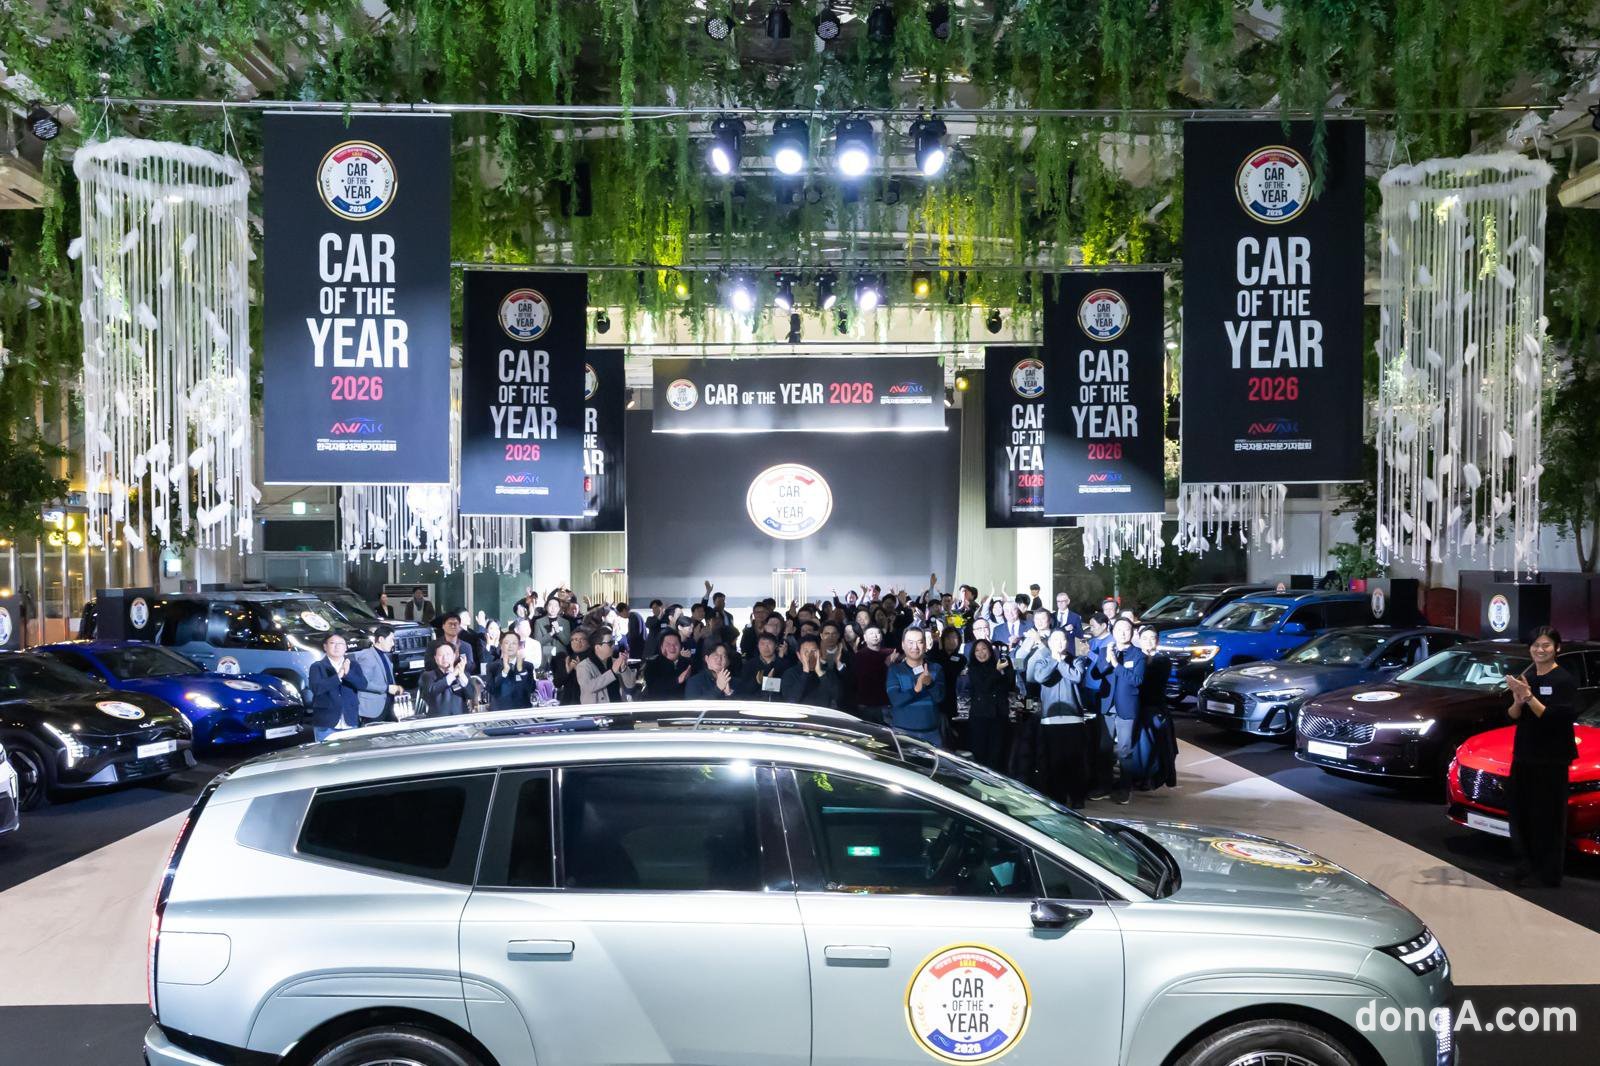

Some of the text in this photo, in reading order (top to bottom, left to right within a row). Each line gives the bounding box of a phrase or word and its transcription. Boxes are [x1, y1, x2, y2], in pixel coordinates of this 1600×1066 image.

[347, 163, 368, 177] CAR
[1264, 167, 1285, 181] CAR
[347, 177, 368, 185] OF THE
[1264, 181, 1285, 189] OF THE
[344, 185, 371, 199] YEAR
[1262, 189, 1288, 203] YEAR
[318, 232, 396, 284] CAR
[1236, 236, 1312, 286] CAR
[319, 287, 395, 315] OF THE
[1237, 289, 1311, 317] OF THE
[306, 318, 409, 369] YEAR
[1223, 319, 1324, 370] YEAR
[498, 349, 550, 383] CAR
[1079, 349, 1129, 382] CAR
[331, 375, 383, 401] 2026
[498, 385, 549, 404] OF THE
[704, 383, 738, 405] CAR
[742, 391, 755, 405] OF
[756, 391, 776, 405] THE
[779, 382, 824, 404] YEAR
[829, 382, 873, 404] 2026
[1079, 384, 1129, 404] OF THE
[1248, 376, 1299, 401] 2026
[489, 405, 558, 440] YEAR
[1071, 404, 1138, 438] YEAR
[583, 434, 598, 449] HE
[1012, 430, 1045, 445] OF TH
[505, 443, 540, 461] 2026
[1006, 445, 1044, 471] YEA
[1087, 443, 1122, 460] 2026
[1018, 474, 1044, 488] 2026
[779, 485, 801, 498] CAR
[776, 506, 804, 518] YEAR
[952, 977, 984, 998] CAR
[952, 1000, 984, 1011] OF THE
[947, 1012, 989, 1033] YEAR
